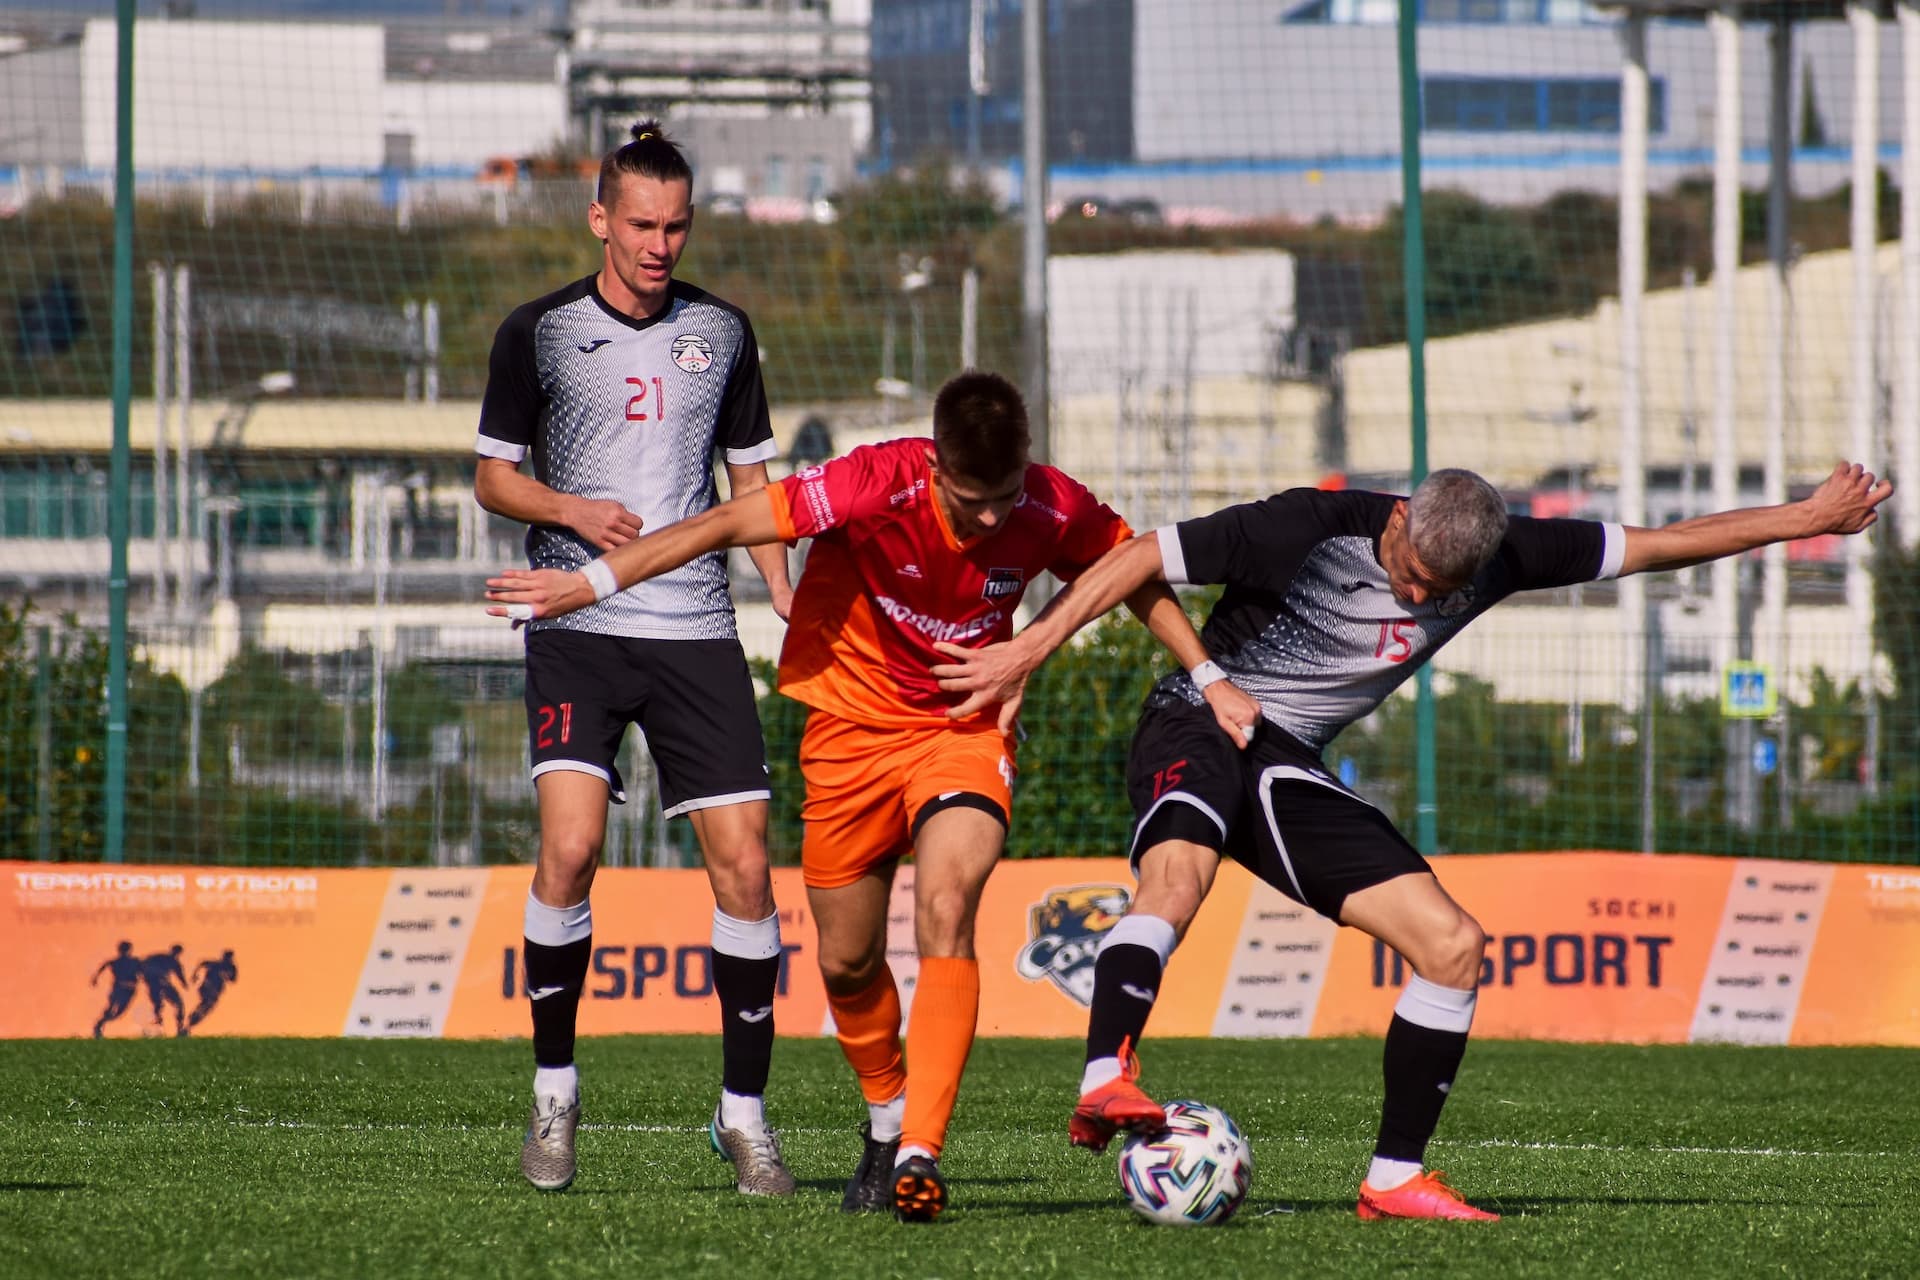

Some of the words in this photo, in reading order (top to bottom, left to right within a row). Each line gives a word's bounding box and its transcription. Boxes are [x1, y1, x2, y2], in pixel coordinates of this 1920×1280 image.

[625, 377, 664, 421] 21
[1375, 619, 1416, 663] 15
[537, 703, 571, 749] 21
[1153, 760, 1187, 800] 15
[1587, 899, 1675, 920] SOCHI
